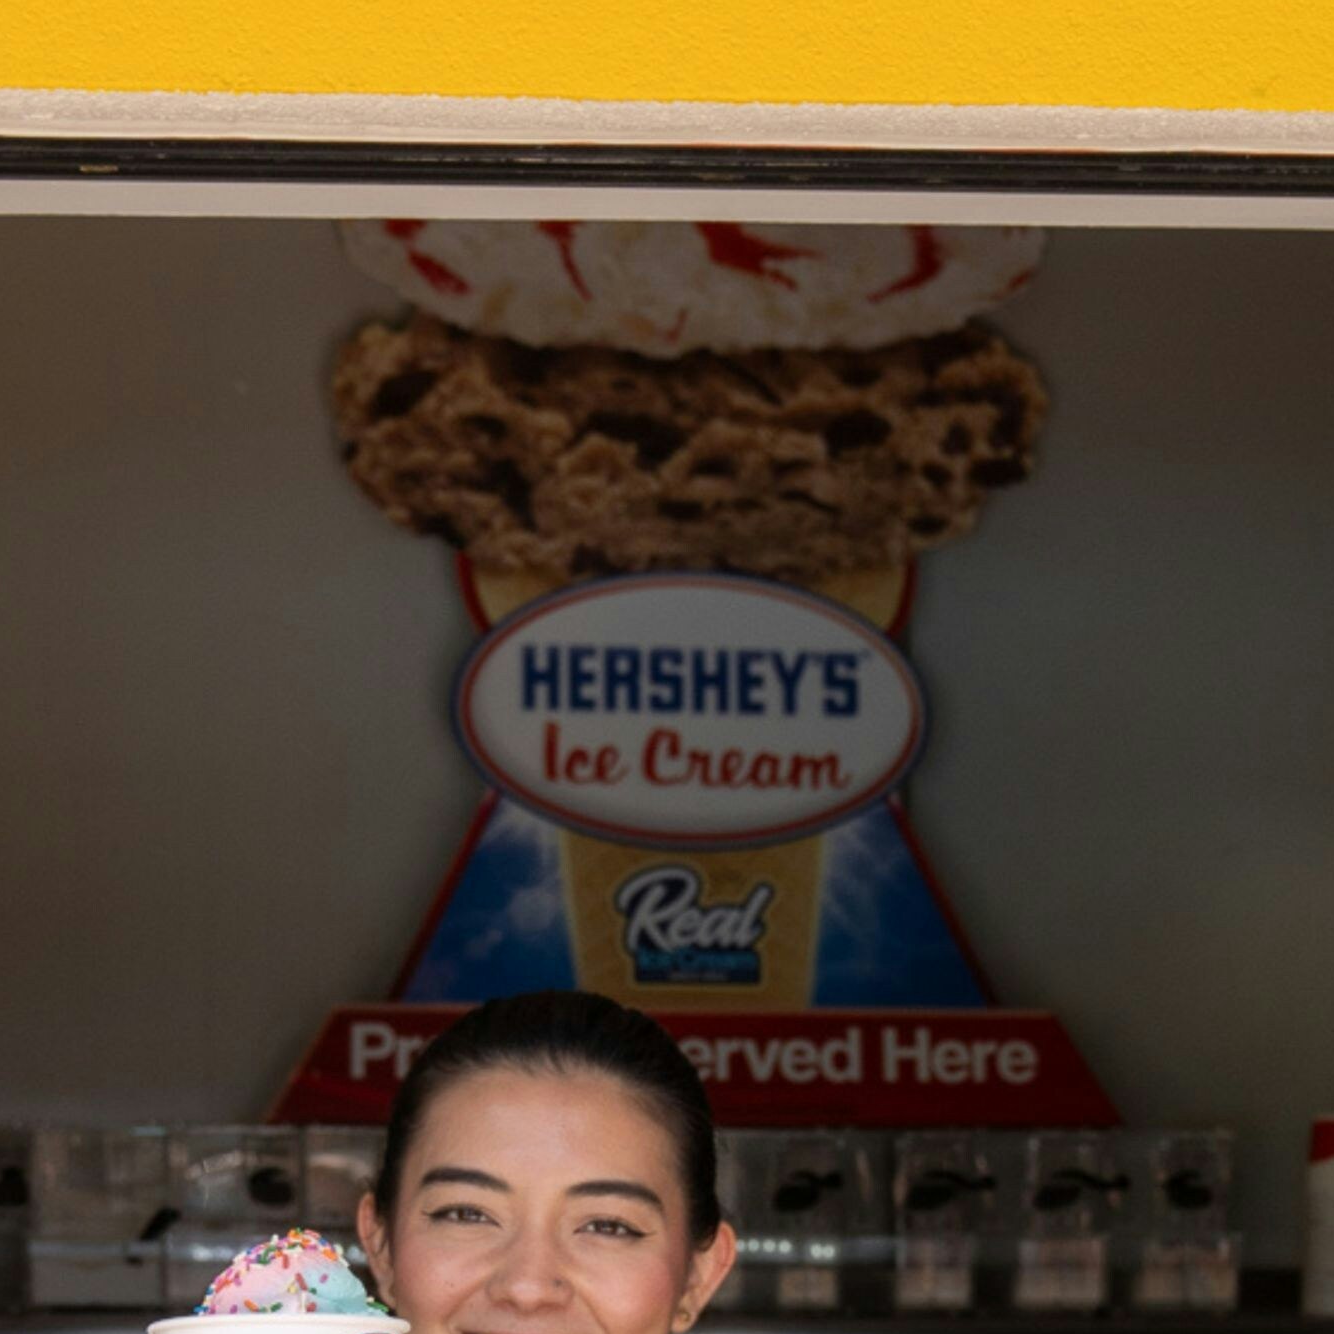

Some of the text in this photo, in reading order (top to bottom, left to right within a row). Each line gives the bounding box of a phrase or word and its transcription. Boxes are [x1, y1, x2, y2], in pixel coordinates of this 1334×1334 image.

[543, 722, 851, 791] Ice Cream
[617, 868, 772, 954] Real
[686, 1028, 859, 1082] erved
[881, 1029, 1037, 1082] Here
